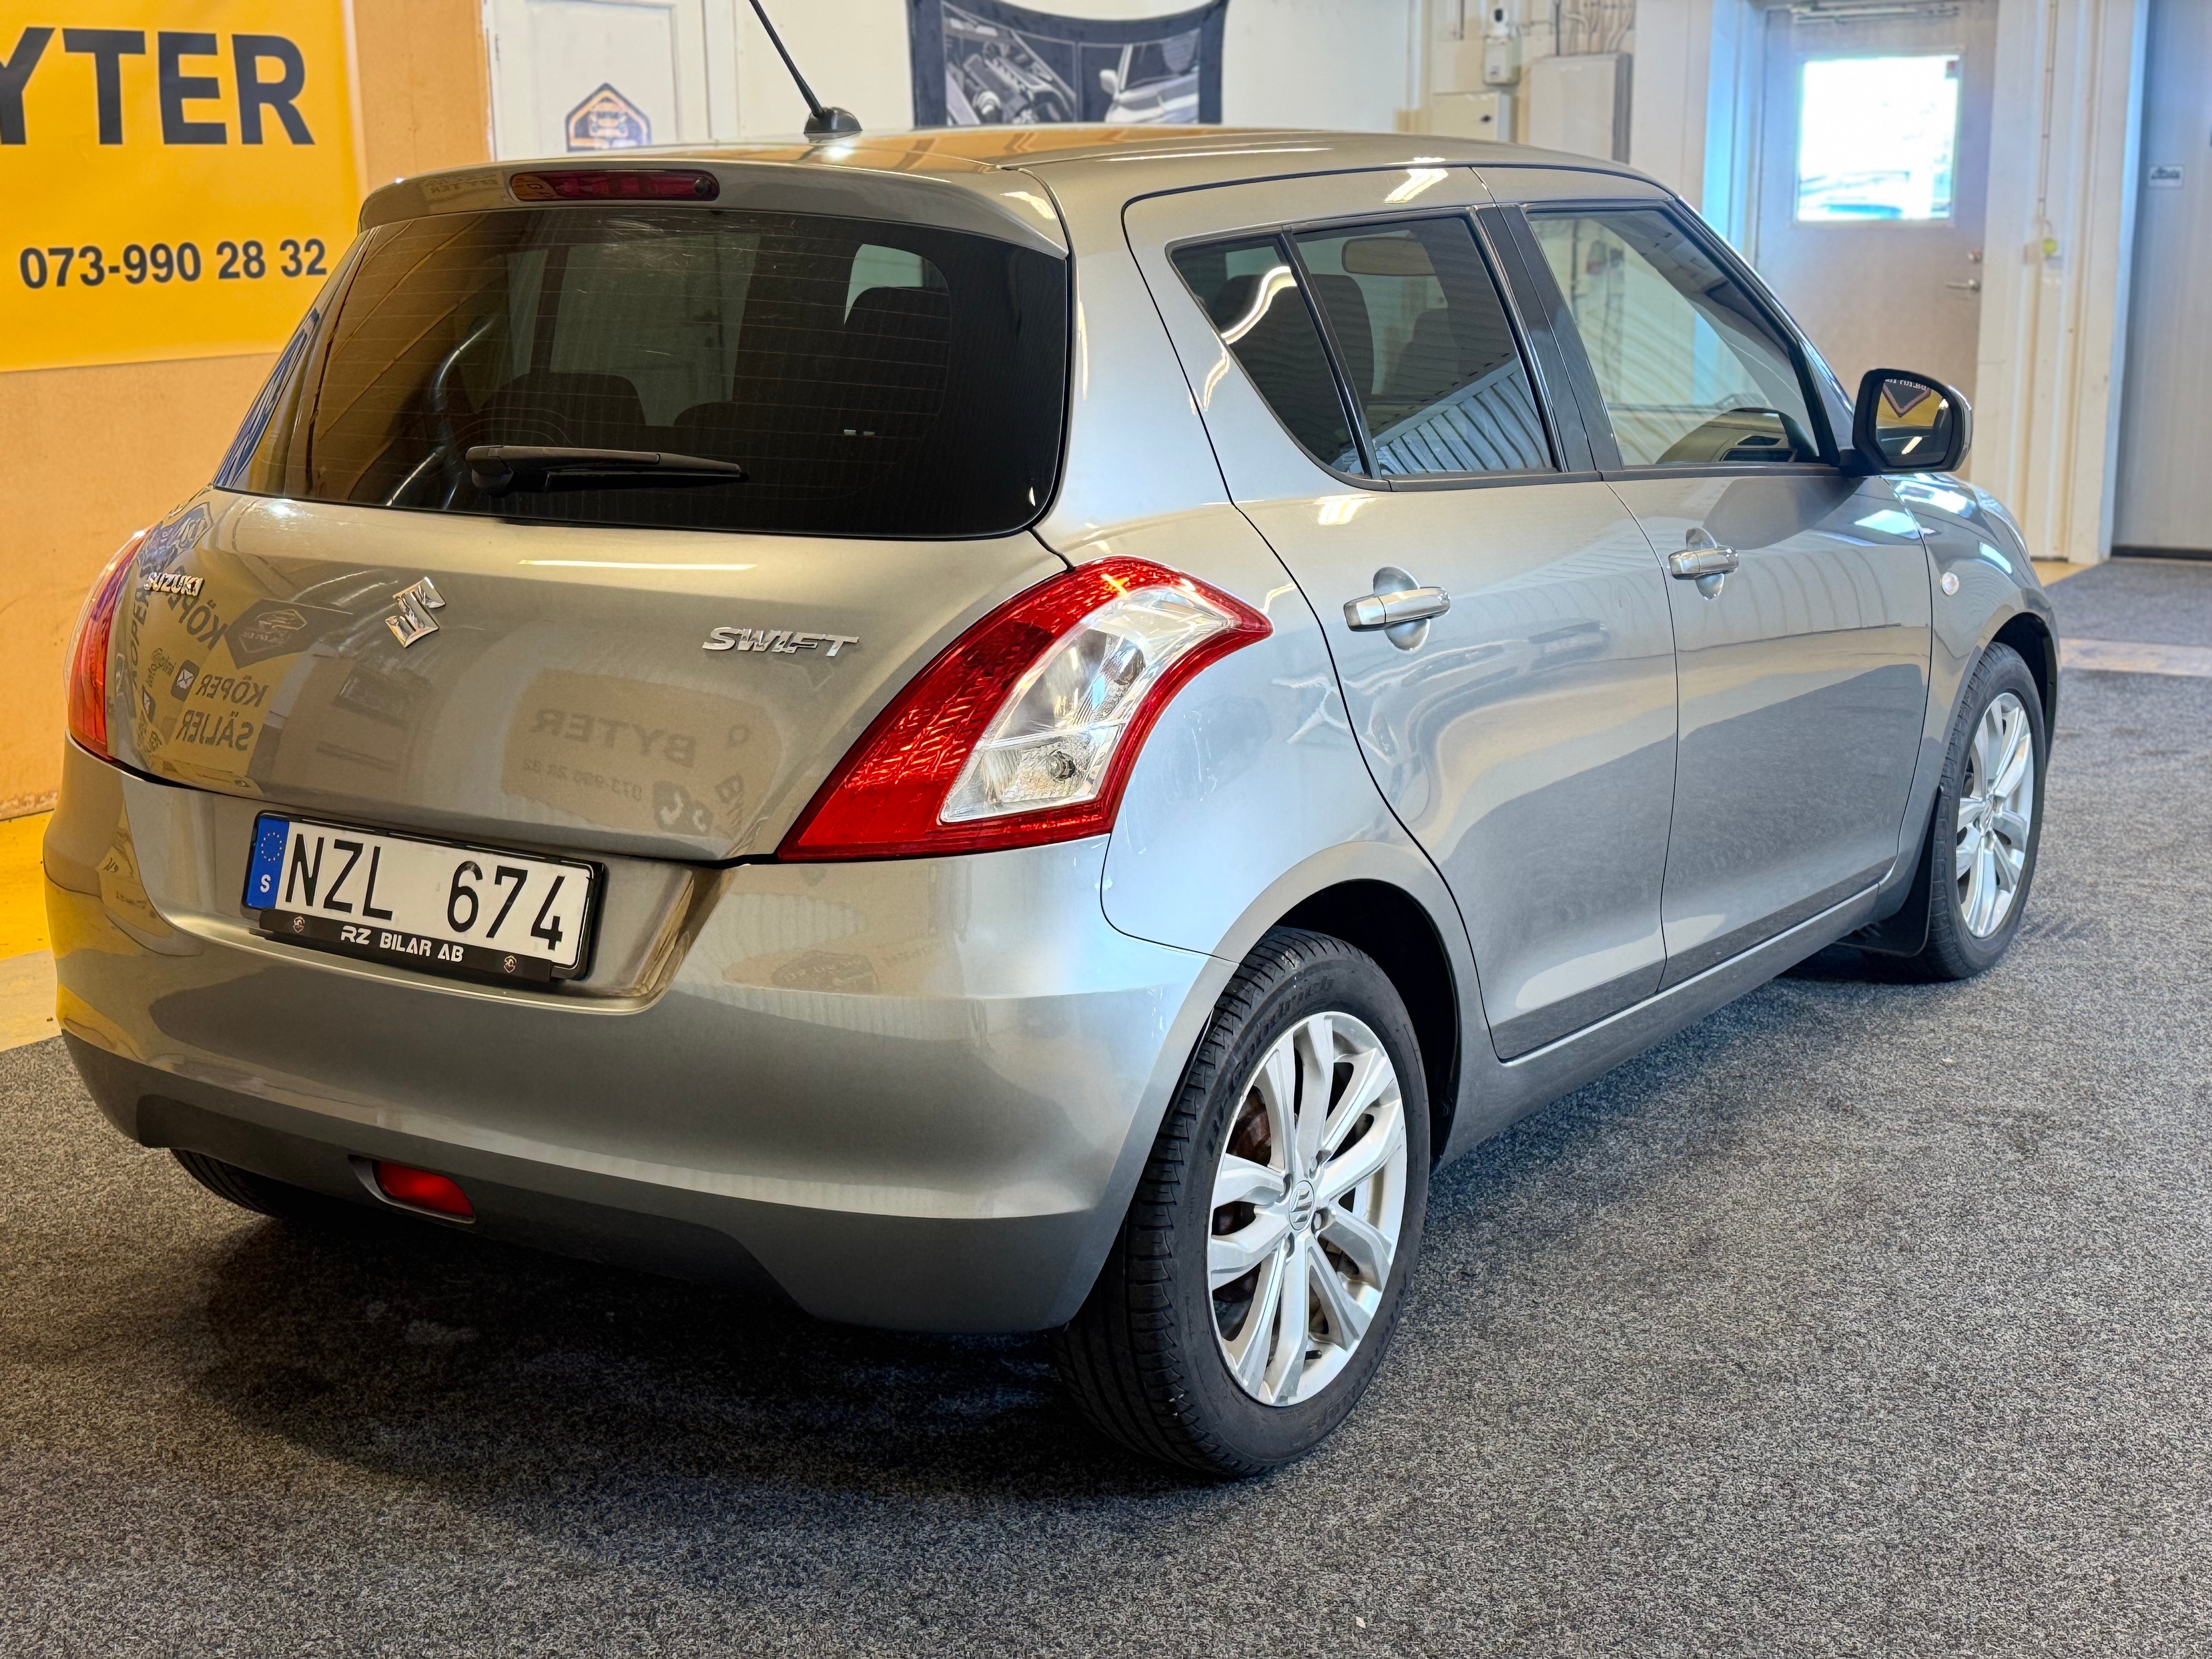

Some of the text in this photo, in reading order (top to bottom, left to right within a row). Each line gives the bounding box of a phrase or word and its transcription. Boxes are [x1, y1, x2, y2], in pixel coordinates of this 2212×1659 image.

[20, 239, 327, 289] 073-990 28 32
[144, 572, 205, 597] SUZUKI
[702, 627, 859, 657] SWIFT
[260, 874, 271, 893] S
[285, 833, 566, 951] NZL 674
[341, 926, 465, 963] RZ BILAR AB
